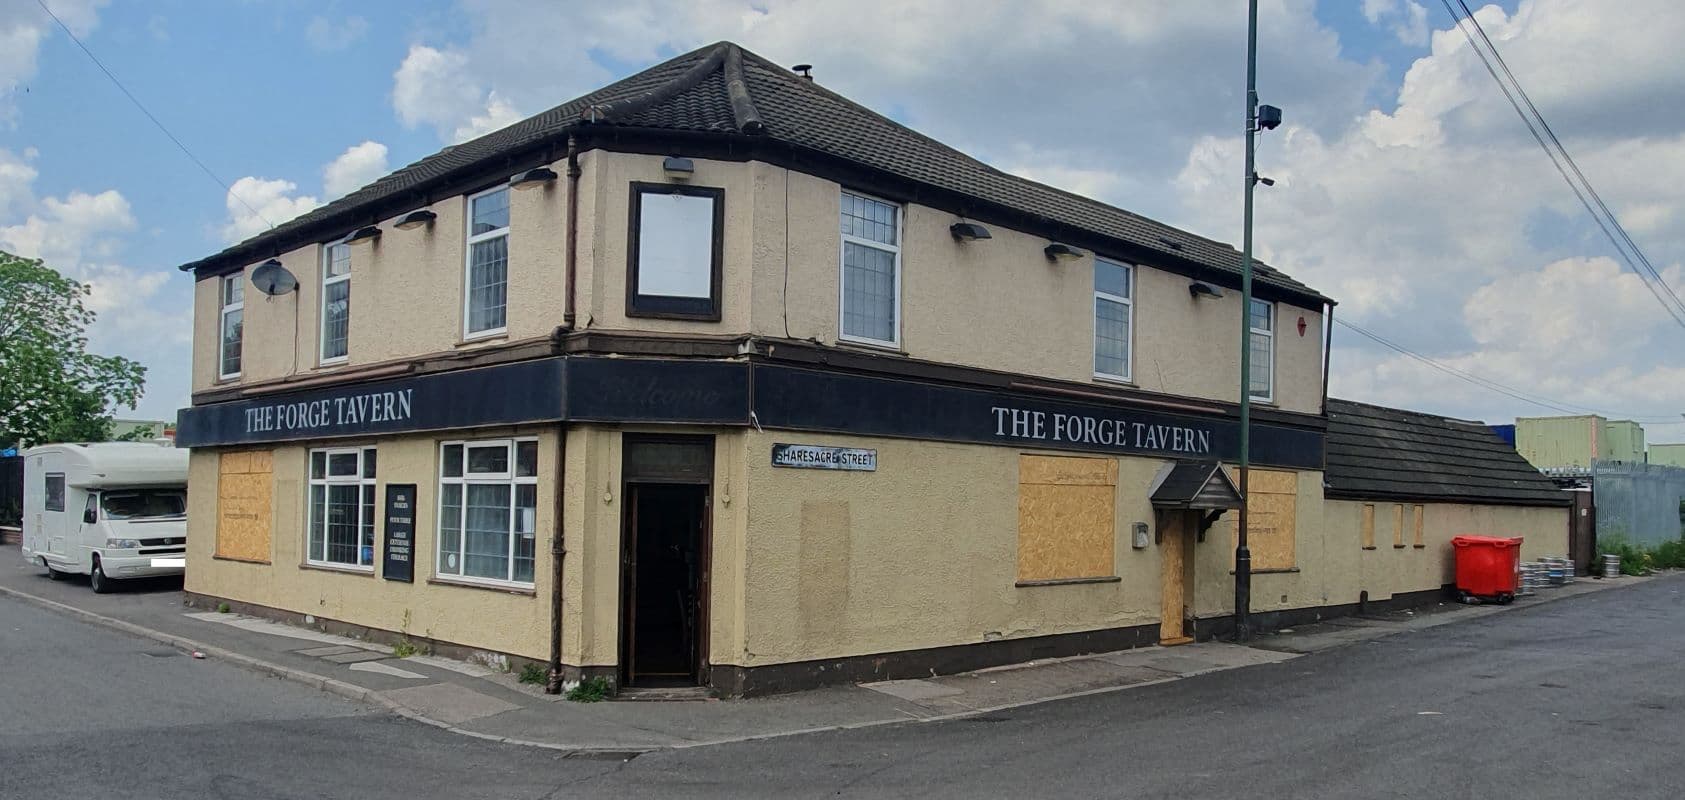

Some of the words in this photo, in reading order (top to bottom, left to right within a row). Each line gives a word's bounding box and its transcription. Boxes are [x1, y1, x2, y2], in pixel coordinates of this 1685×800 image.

[245, 406, 273, 433] THE
[276, 399, 330, 430] FORGE
[335, 389, 413, 425] TAVERN
[991, 406, 1046, 440] THE
[1053, 413, 1126, 446] FORGE
[1132, 422, 1210, 453] TAVERN
[776, 449, 838, 464] SHARESACRE
[841, 453, 873, 466] STREET
